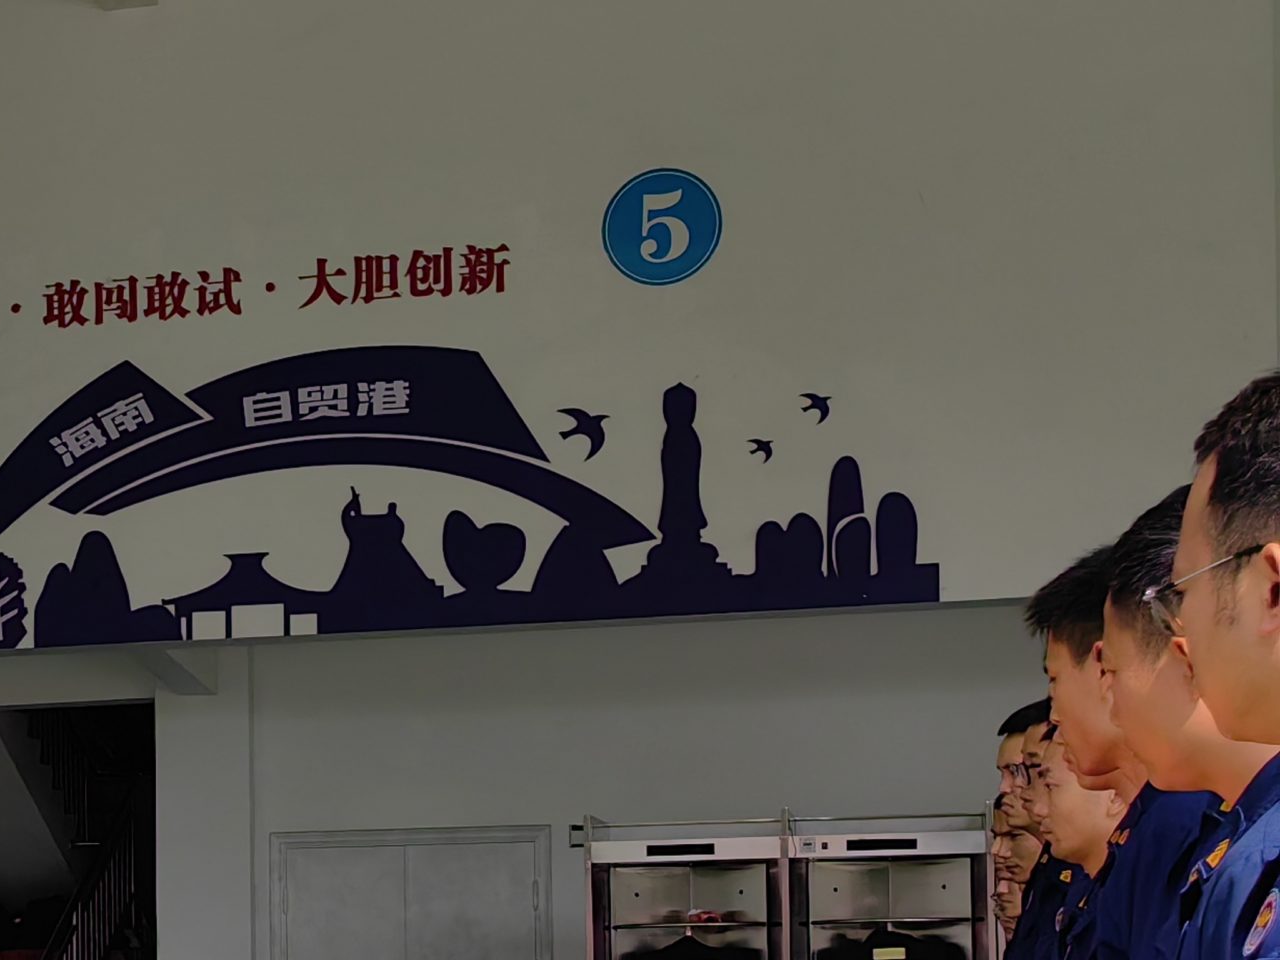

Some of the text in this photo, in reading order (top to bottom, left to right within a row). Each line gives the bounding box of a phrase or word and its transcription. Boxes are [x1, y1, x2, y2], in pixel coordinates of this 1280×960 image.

[638, 188, 691, 264] 5
[48, 378, 411, 468] 海南 自贸港
